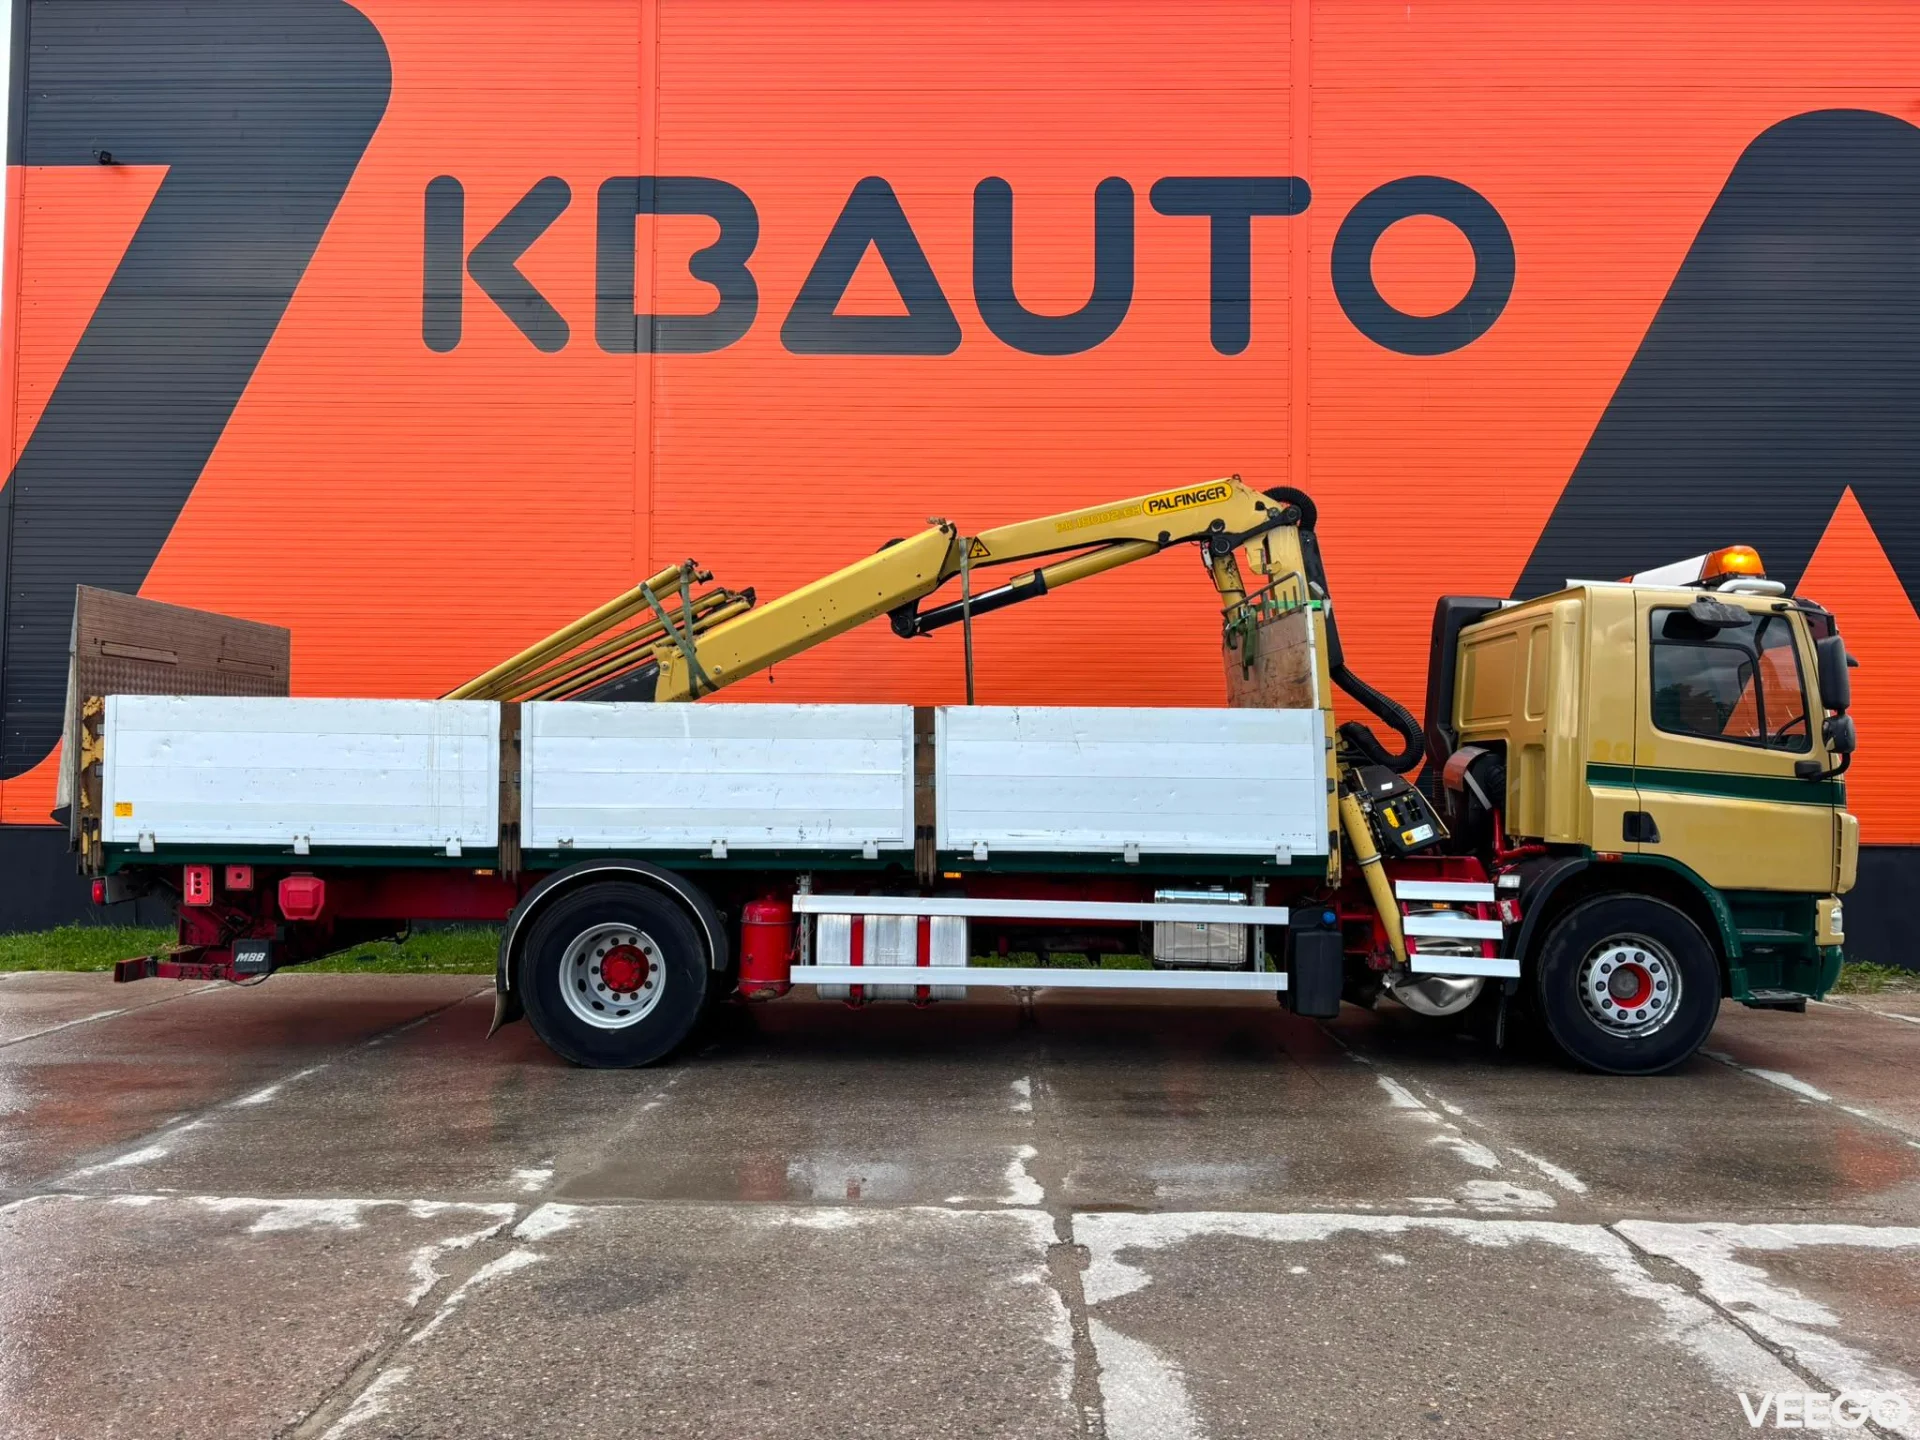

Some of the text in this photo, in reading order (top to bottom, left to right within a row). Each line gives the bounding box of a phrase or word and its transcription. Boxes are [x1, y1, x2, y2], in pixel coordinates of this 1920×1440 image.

[422, 174, 1516, 356] KBAUTO
[1148, 485, 1228, 513] PALFINGER
[235, 952, 266, 962] MBB
